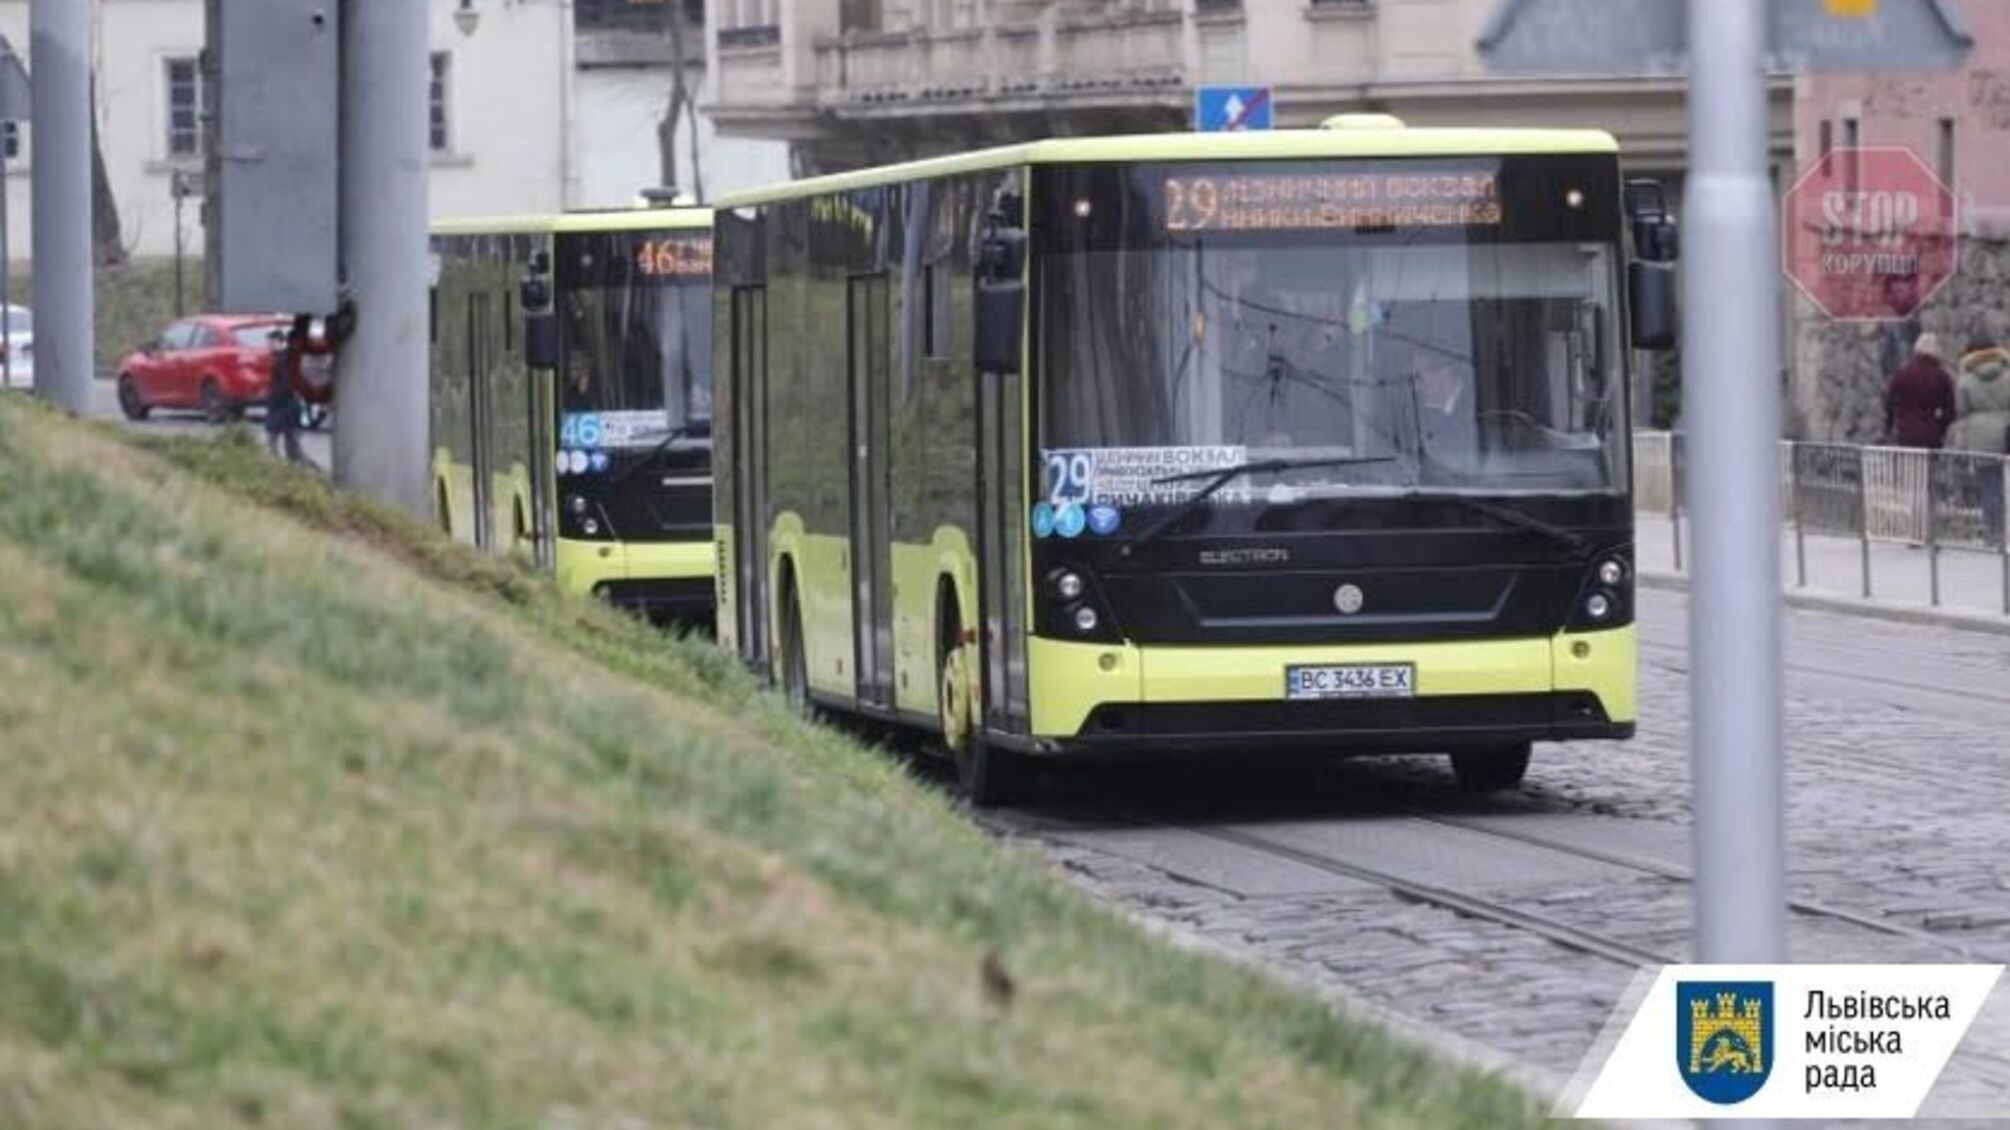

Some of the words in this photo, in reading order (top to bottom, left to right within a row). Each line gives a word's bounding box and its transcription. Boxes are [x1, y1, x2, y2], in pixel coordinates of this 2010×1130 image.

[1165, 178, 1218, 230] 29
[637, 239, 674, 275] 46
[560, 413, 600, 447] 46
[1049, 453, 1093, 505] 29
[1333, 670, 1377, 688] 3436
